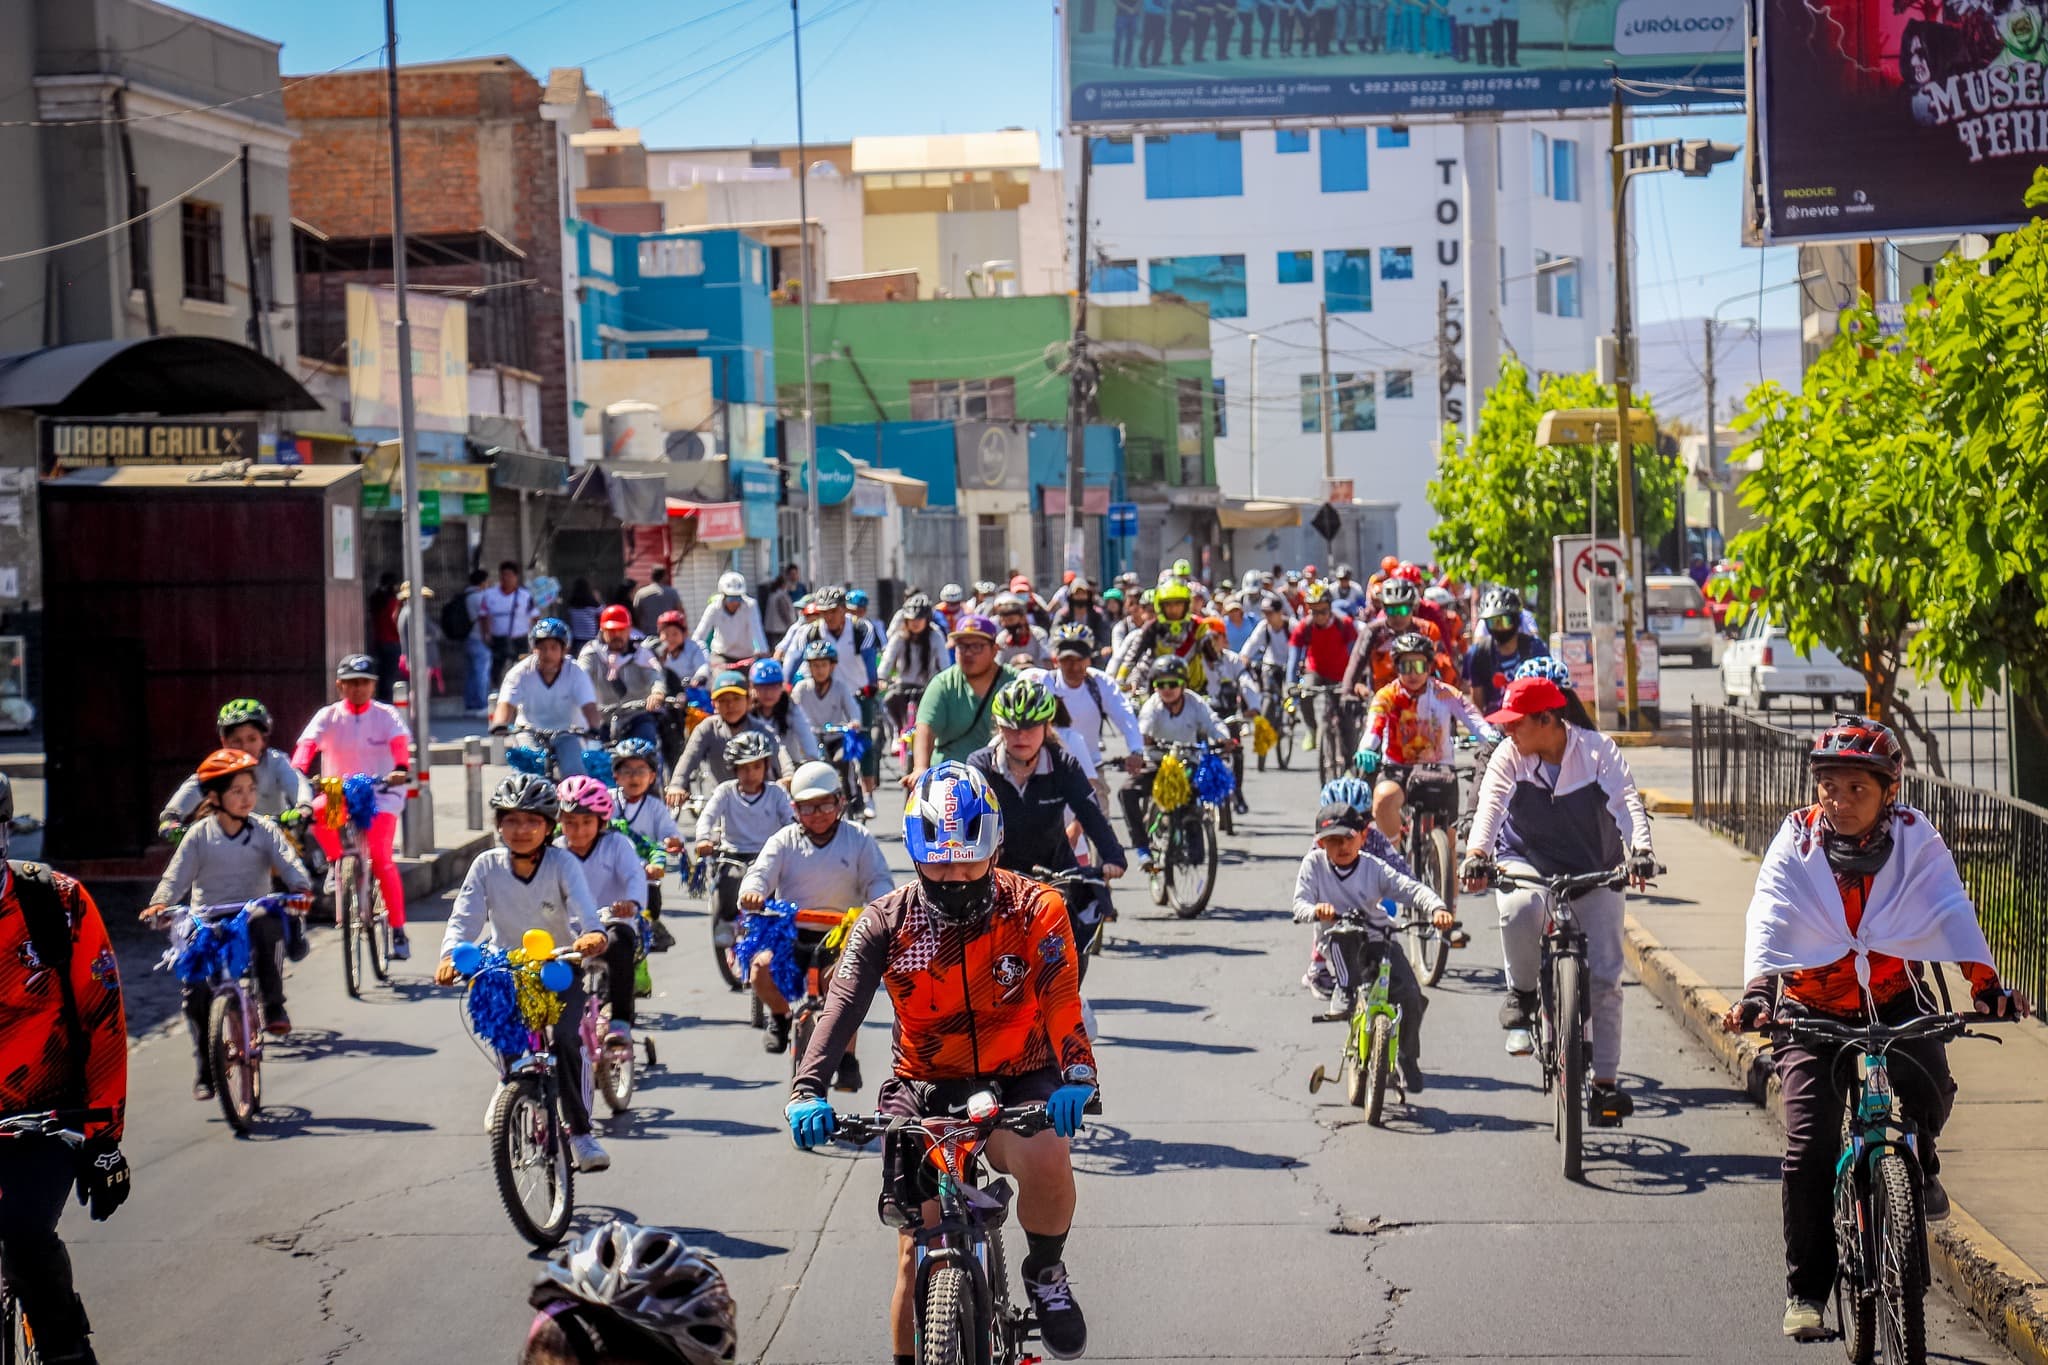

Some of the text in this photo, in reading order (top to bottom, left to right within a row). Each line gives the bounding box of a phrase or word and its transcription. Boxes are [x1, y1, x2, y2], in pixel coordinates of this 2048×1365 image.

[1624, 15, 1734, 37] ¿URÓLOGO?
[1922, 62, 2048, 124] MUSE
[1800, 205, 1840, 218] nevte
[54, 426, 219, 455] URBAN GRILL
[928, 850, 974, 862] Red Bull
